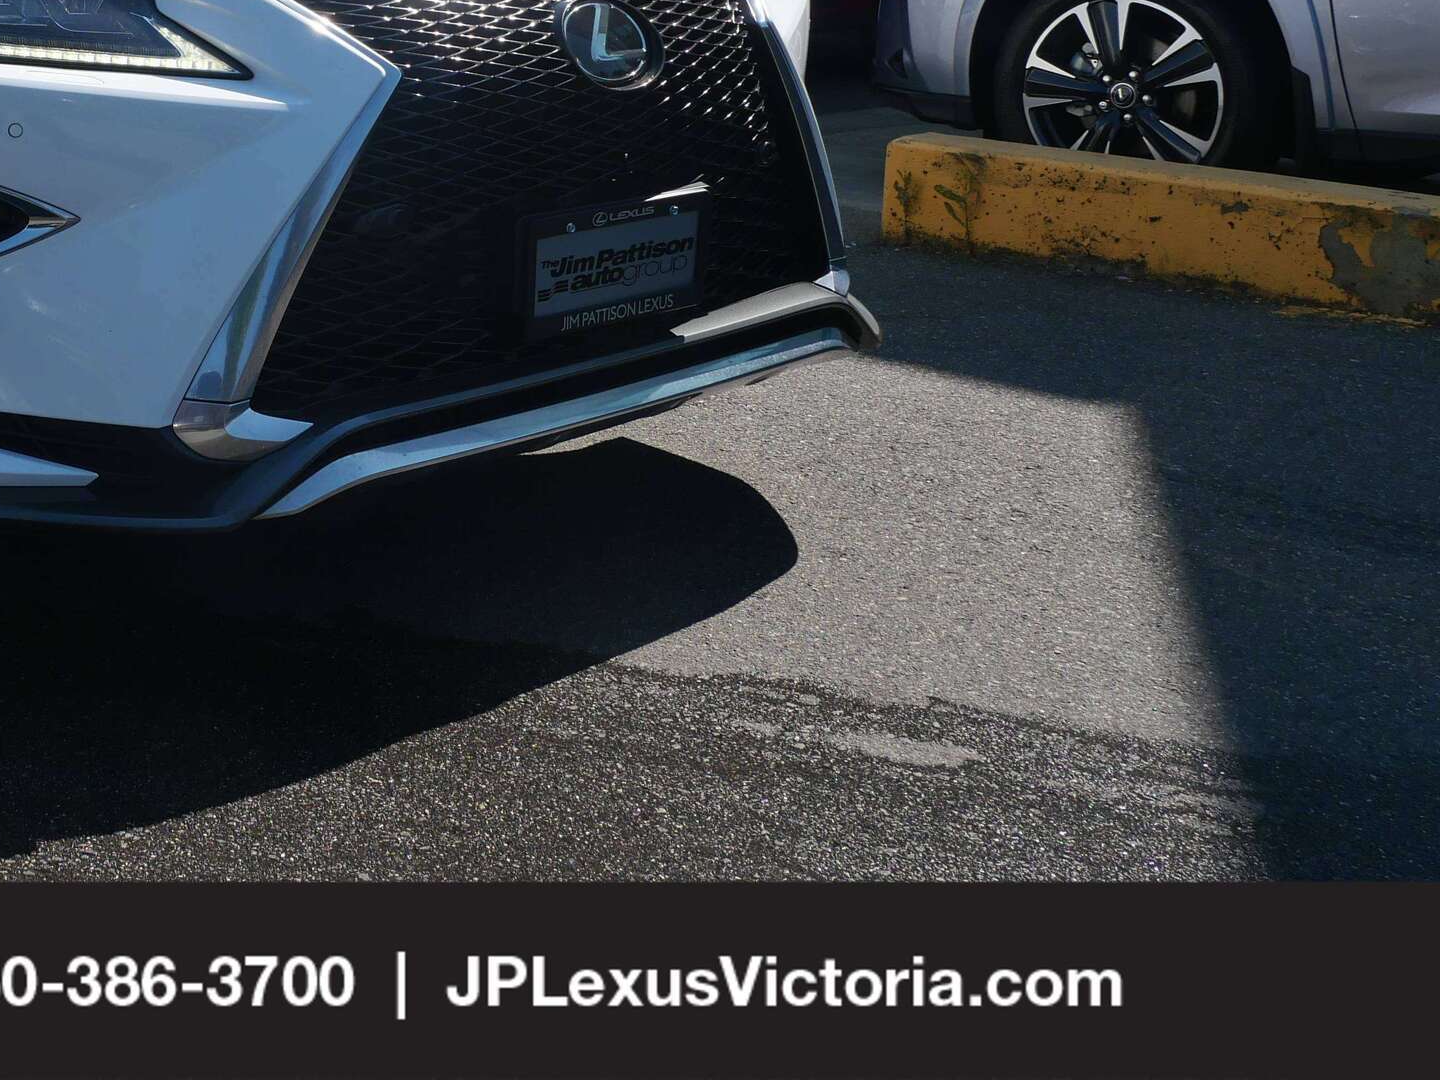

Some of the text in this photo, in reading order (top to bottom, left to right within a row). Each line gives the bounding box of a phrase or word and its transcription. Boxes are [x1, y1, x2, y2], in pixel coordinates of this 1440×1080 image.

[609, 206, 655, 221] LEXUS
[551, 255, 594, 278] Jim
[596, 236, 695, 269] Pattison
[560, 294, 674, 332] JIM PATTISON LEXUS
